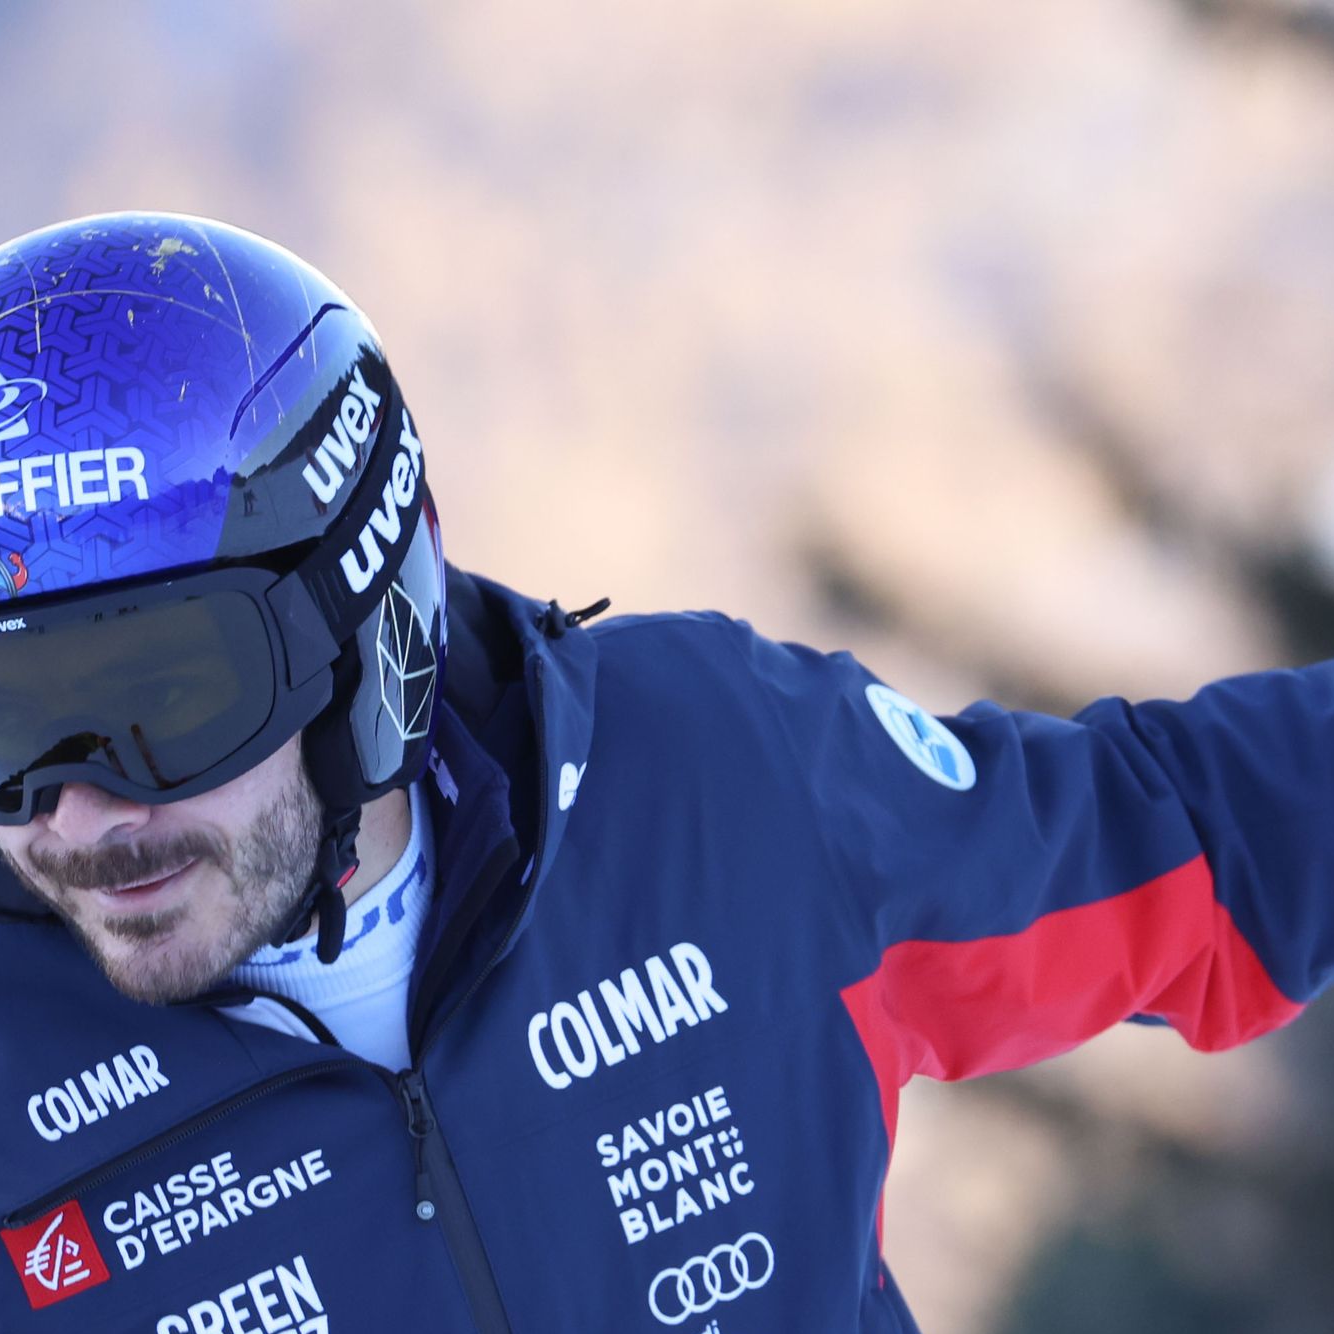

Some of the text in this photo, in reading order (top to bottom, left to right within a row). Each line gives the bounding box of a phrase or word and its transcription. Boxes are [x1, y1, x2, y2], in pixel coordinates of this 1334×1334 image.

[302, 365, 381, 504] uvex
[340, 408, 422, 594] uvex
[528, 942, 728, 1090] COLMAR
[27, 1045, 170, 1142] COLMAR
[596, 1085, 732, 1168] SAVOIE
[103, 1151, 241, 1234] CAISSE
[115, 1149, 332, 1270] D'EPARGNE
[607, 1133, 716, 1208] MONT
[619, 1161, 755, 1244] BLANC
